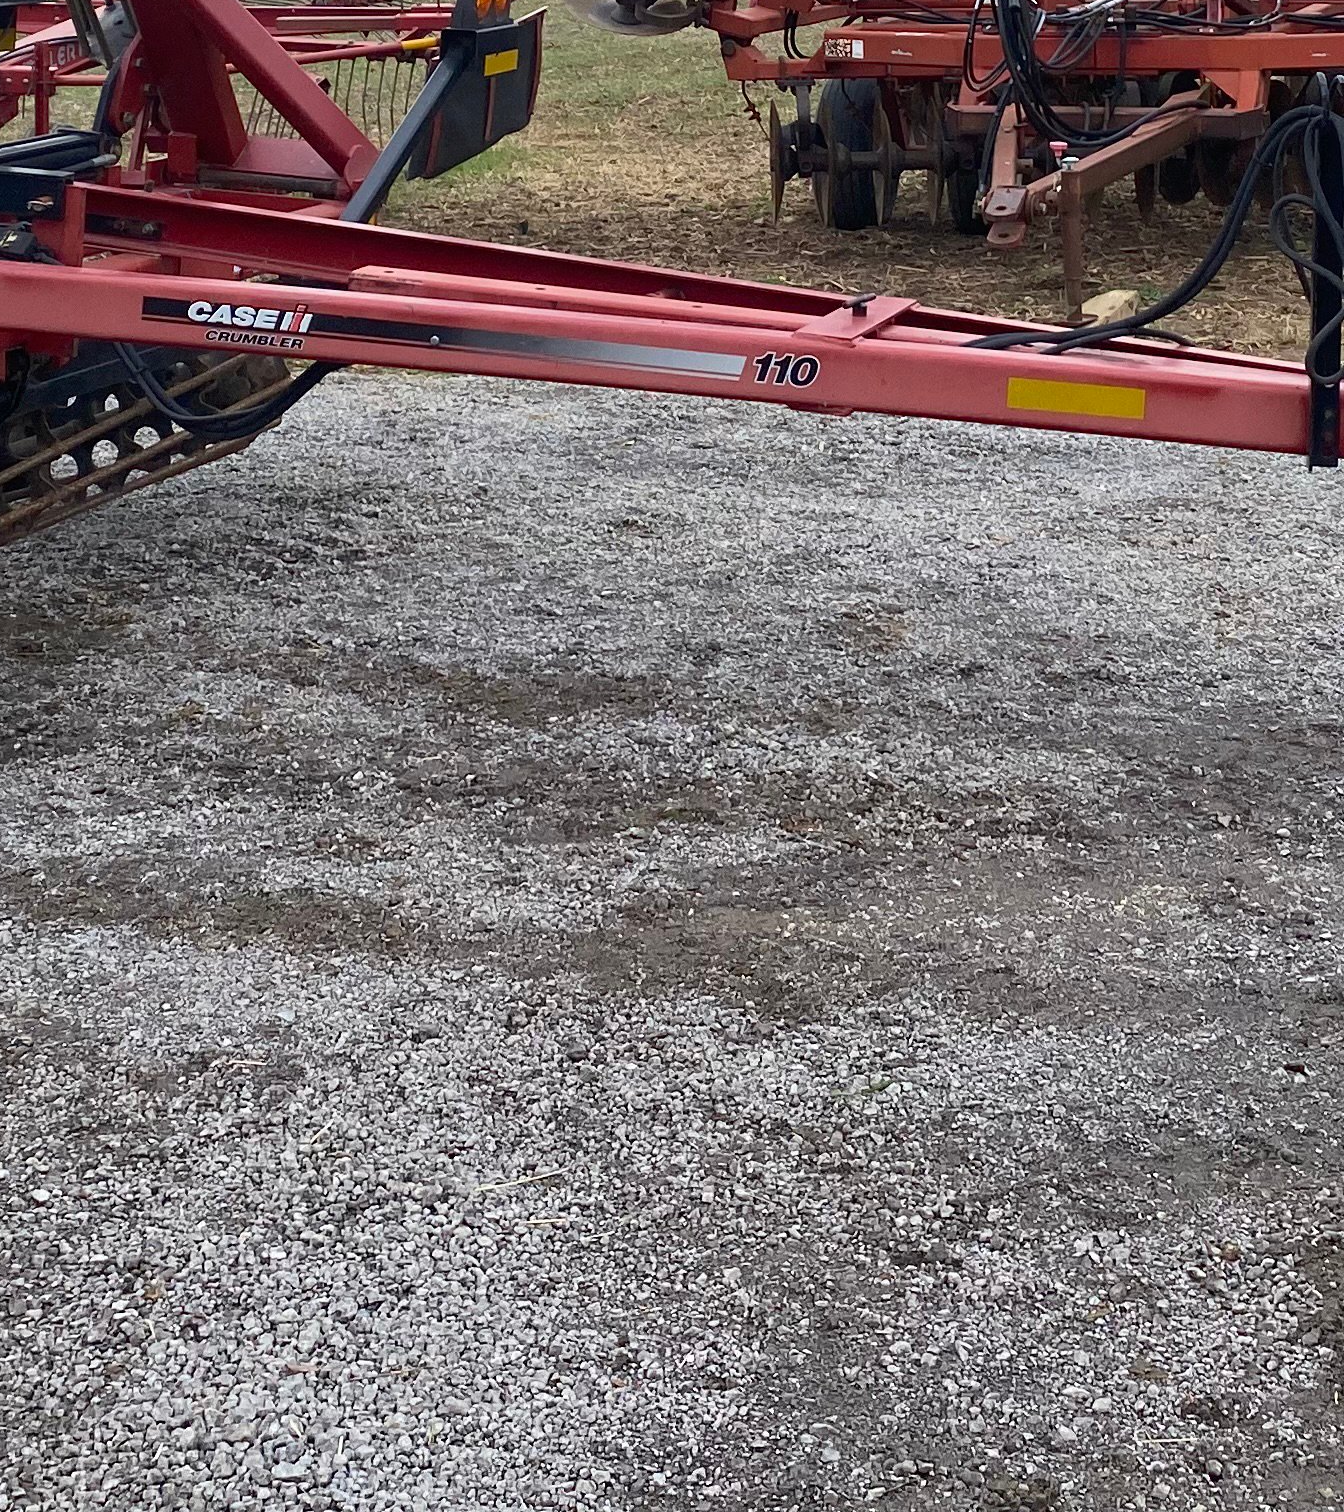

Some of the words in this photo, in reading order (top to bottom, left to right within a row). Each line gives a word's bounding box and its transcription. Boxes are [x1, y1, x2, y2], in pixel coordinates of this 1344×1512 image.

[187, 300, 281, 330] CASE
[205, 330, 305, 350] CRUMBLER
[753, 351, 821, 388] 110
